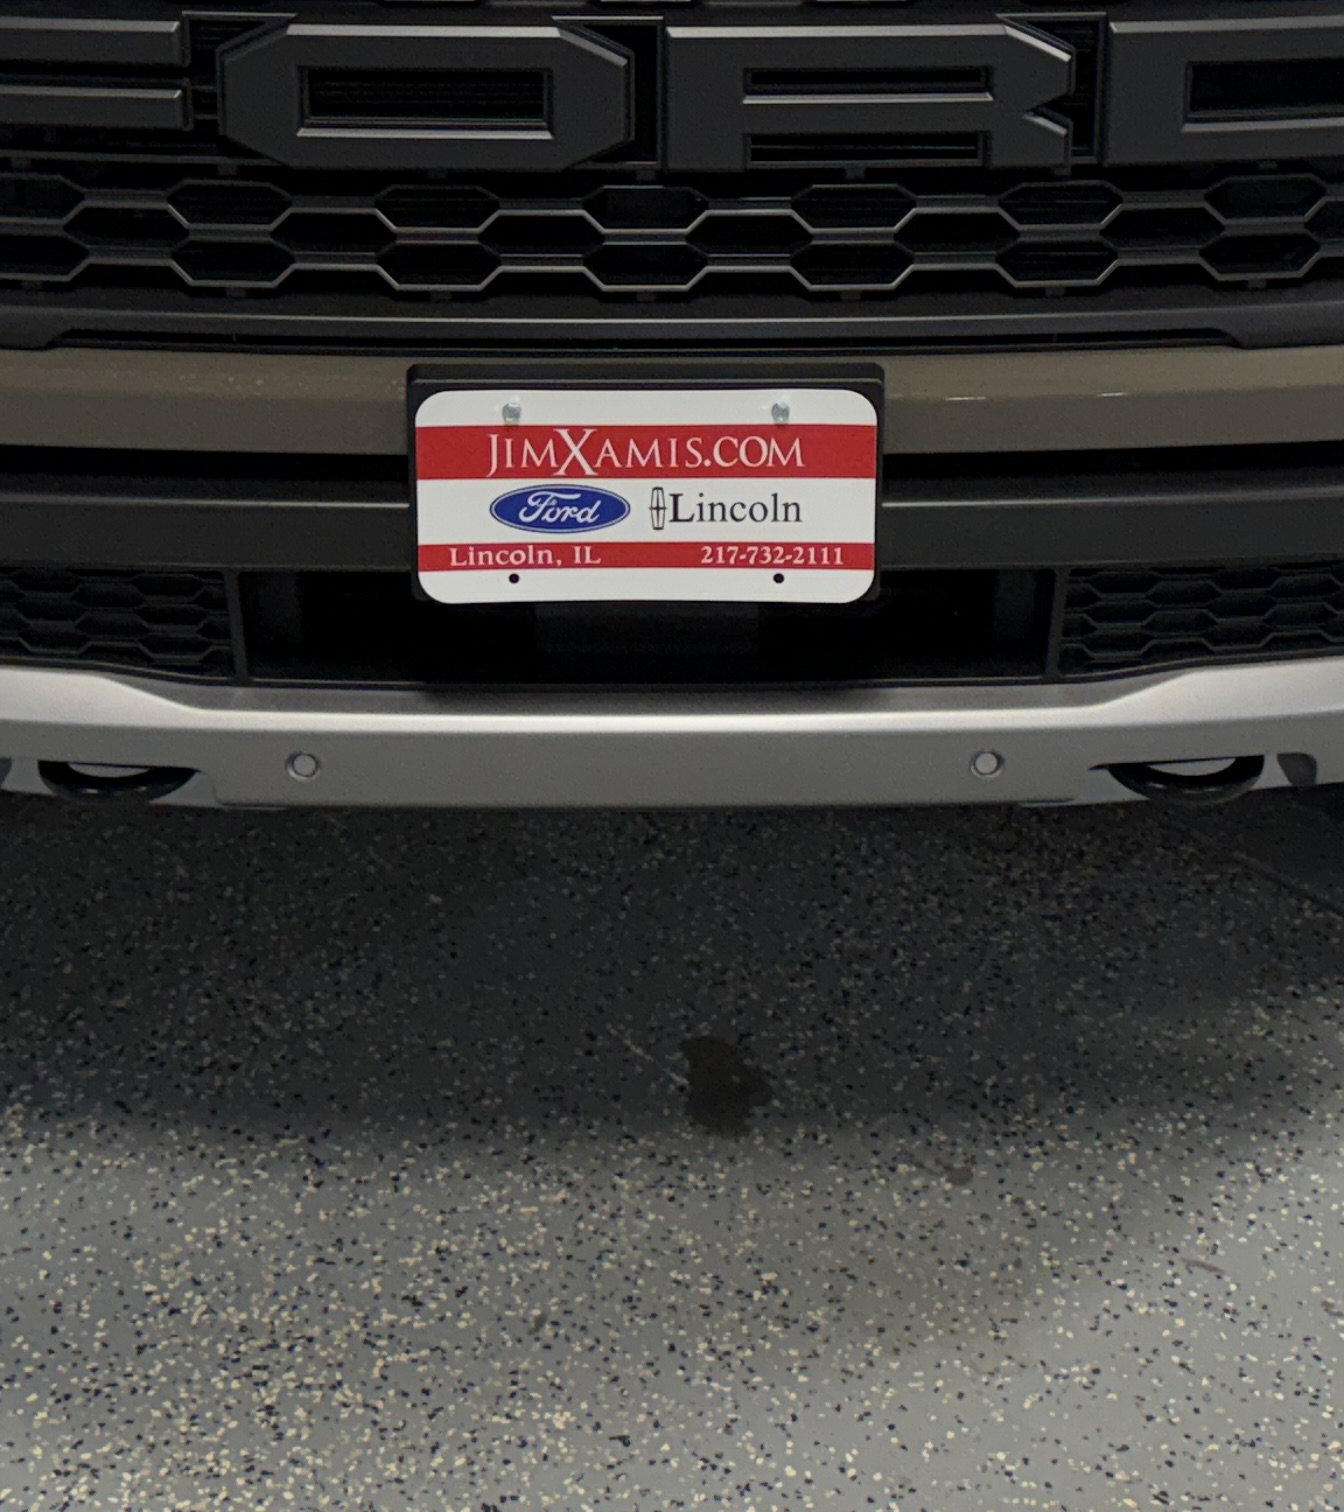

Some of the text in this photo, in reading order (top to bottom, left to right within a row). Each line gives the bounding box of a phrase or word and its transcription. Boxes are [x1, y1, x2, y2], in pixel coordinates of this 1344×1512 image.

[518, 490, 602, 525] Ford
[669, 492, 804, 524] Lincoln
[448, 545, 602, 568] Lincoln, IL
[700, 545, 844, 566] 217-732-2111
